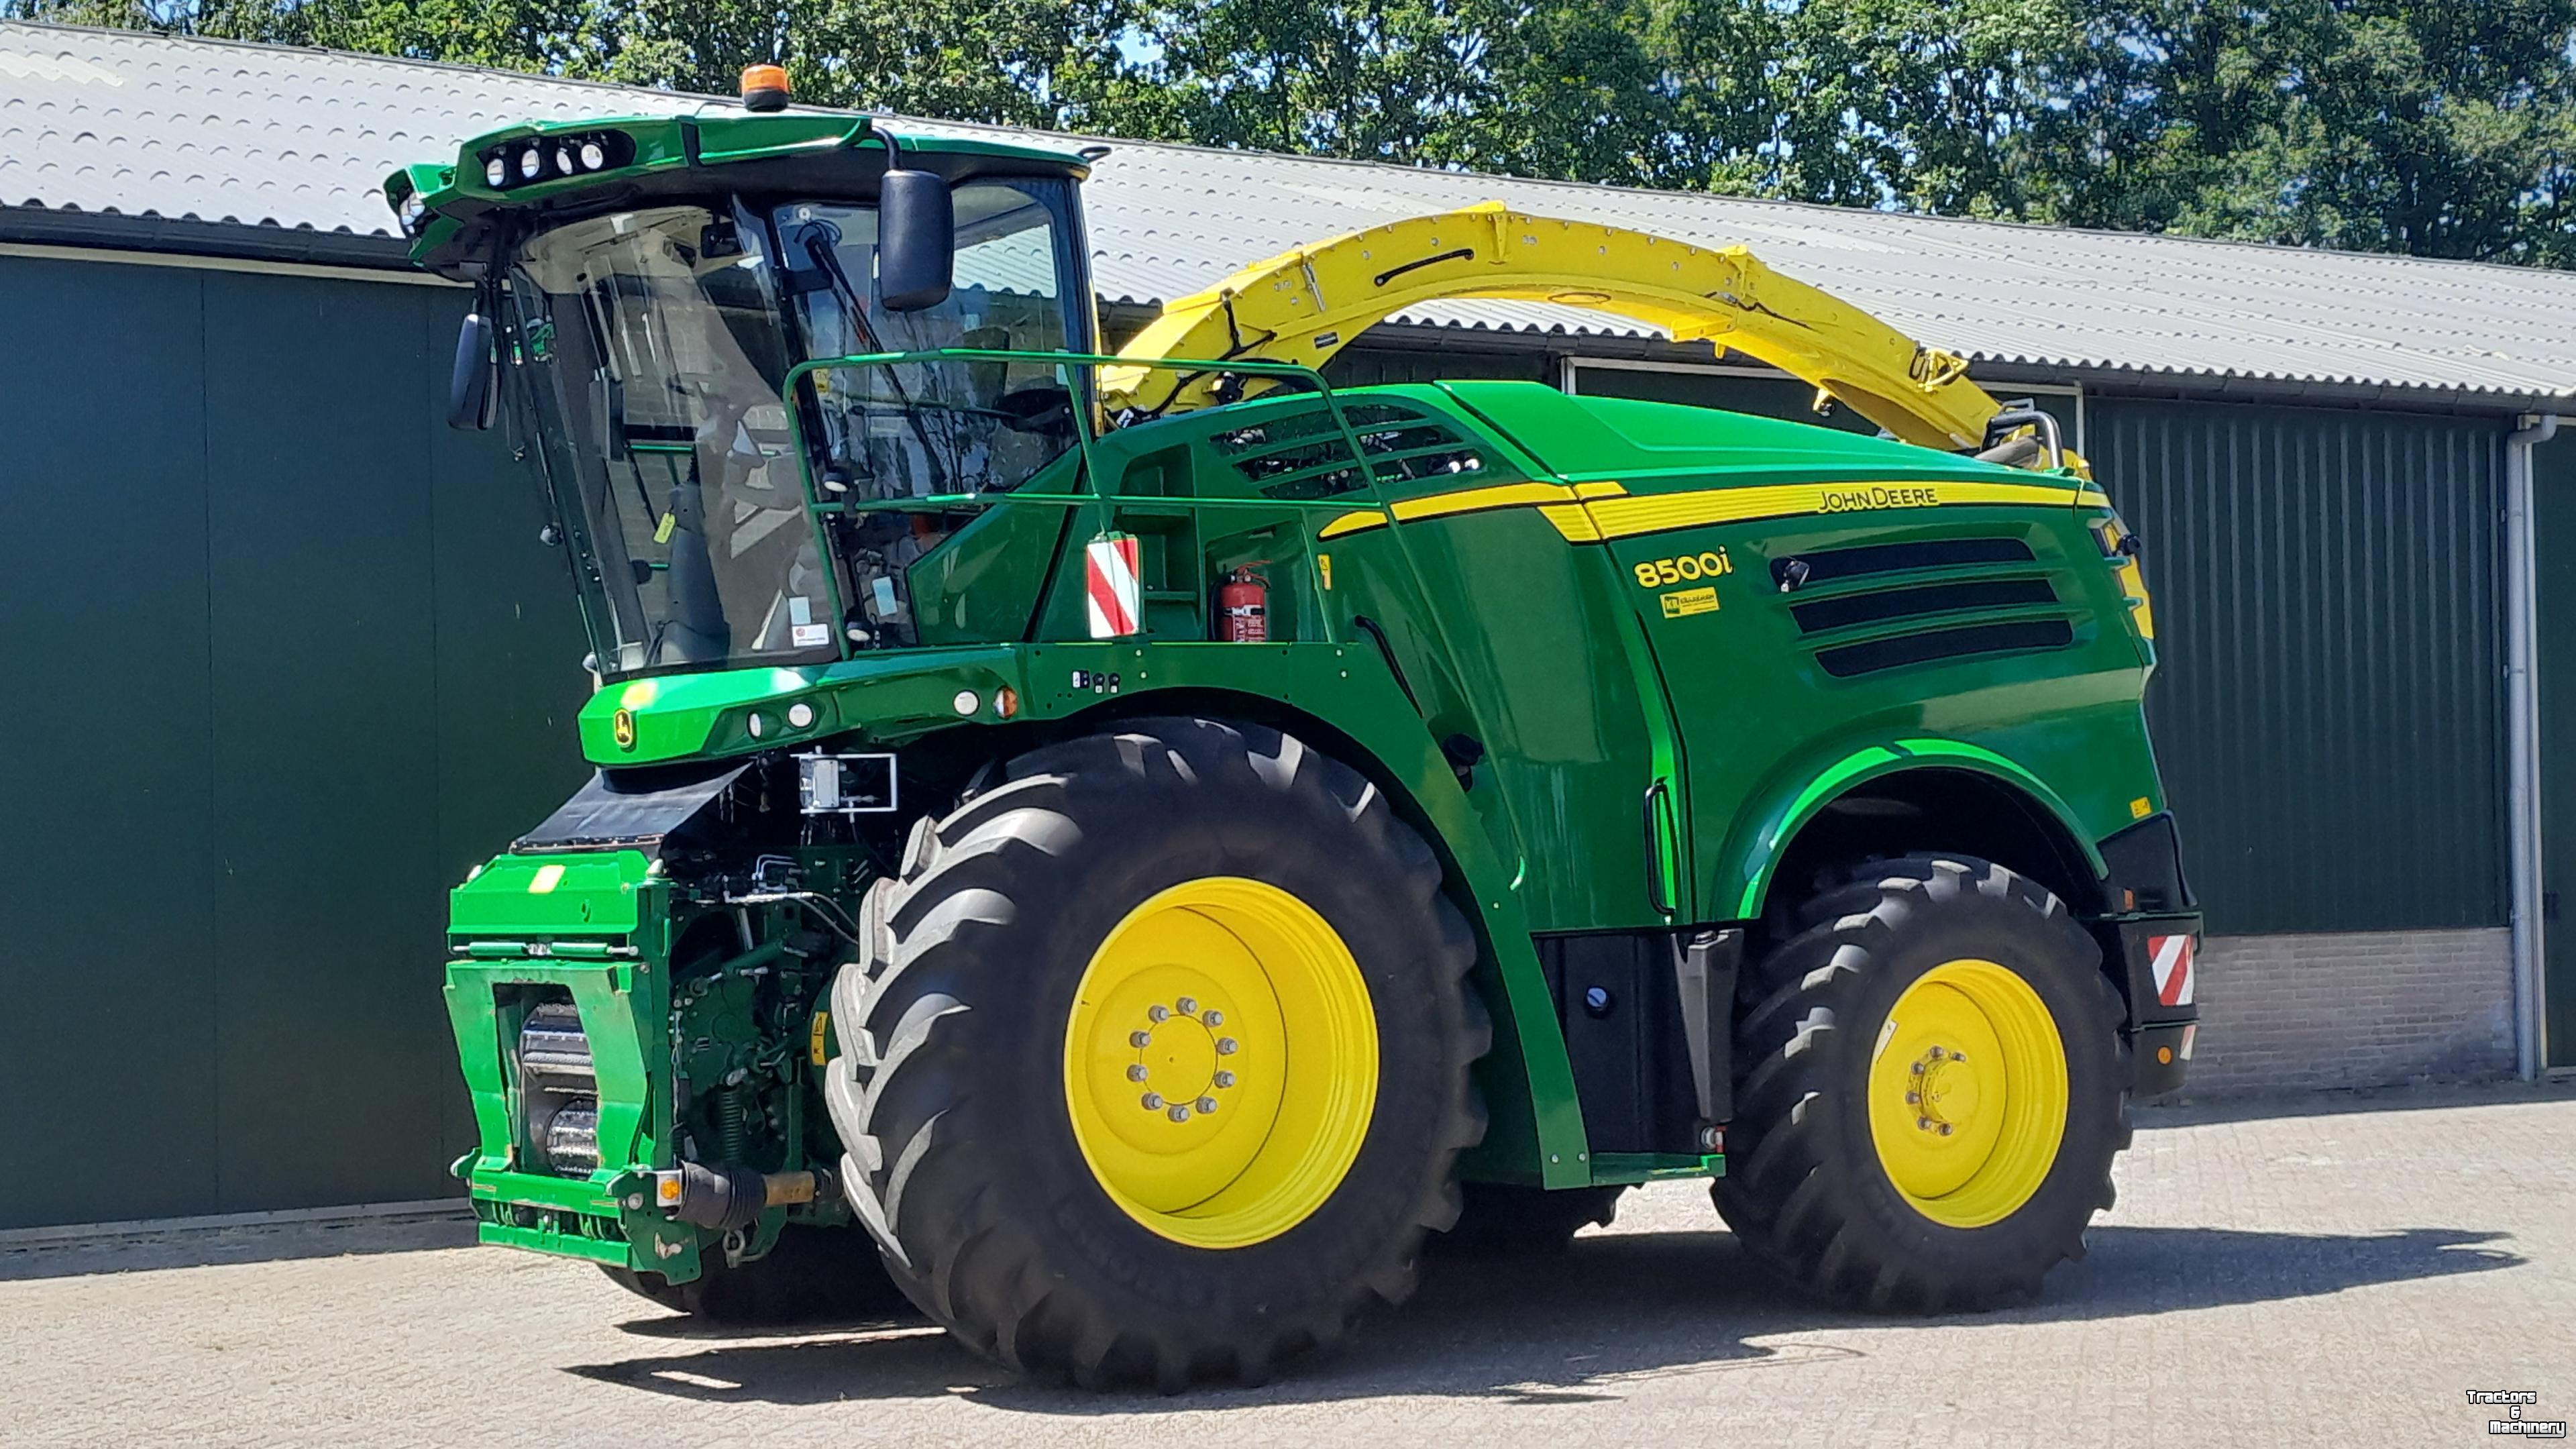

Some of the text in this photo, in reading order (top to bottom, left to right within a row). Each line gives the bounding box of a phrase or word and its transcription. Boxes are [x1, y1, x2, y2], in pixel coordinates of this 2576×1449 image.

[1819, 487, 1938, 510] JOHN DEERE
[1633, 545, 1733, 588] 8500i
